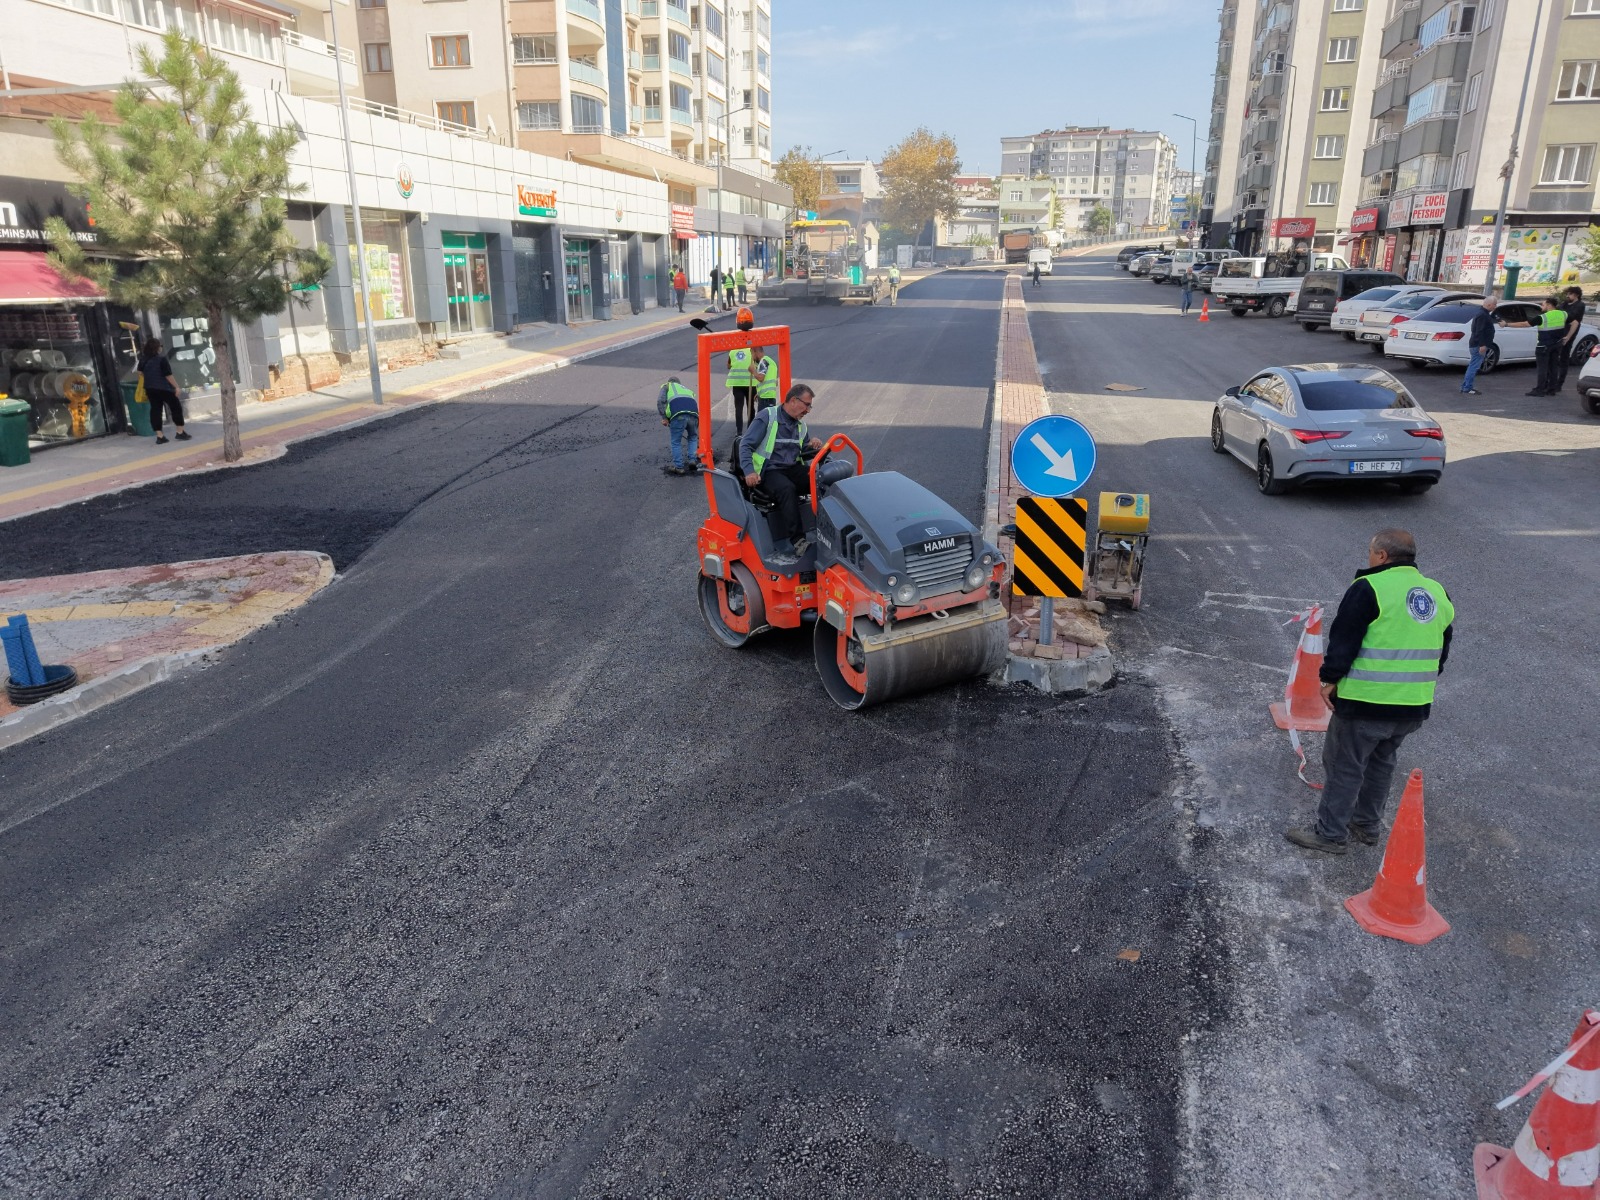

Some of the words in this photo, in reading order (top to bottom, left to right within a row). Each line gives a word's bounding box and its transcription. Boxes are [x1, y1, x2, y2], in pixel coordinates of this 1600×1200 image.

[1424, 194, 1446, 207] EVCİL
[1412, 208, 1445, 219] PETSHOP
[0, 229, 39, 239] MİNSAN
[1355, 463, 1364, 471] 16
[1370, 462, 1386, 471] HEF
[1390, 462, 1400, 470] 72
[924, 538, 955, 552] HAMM
